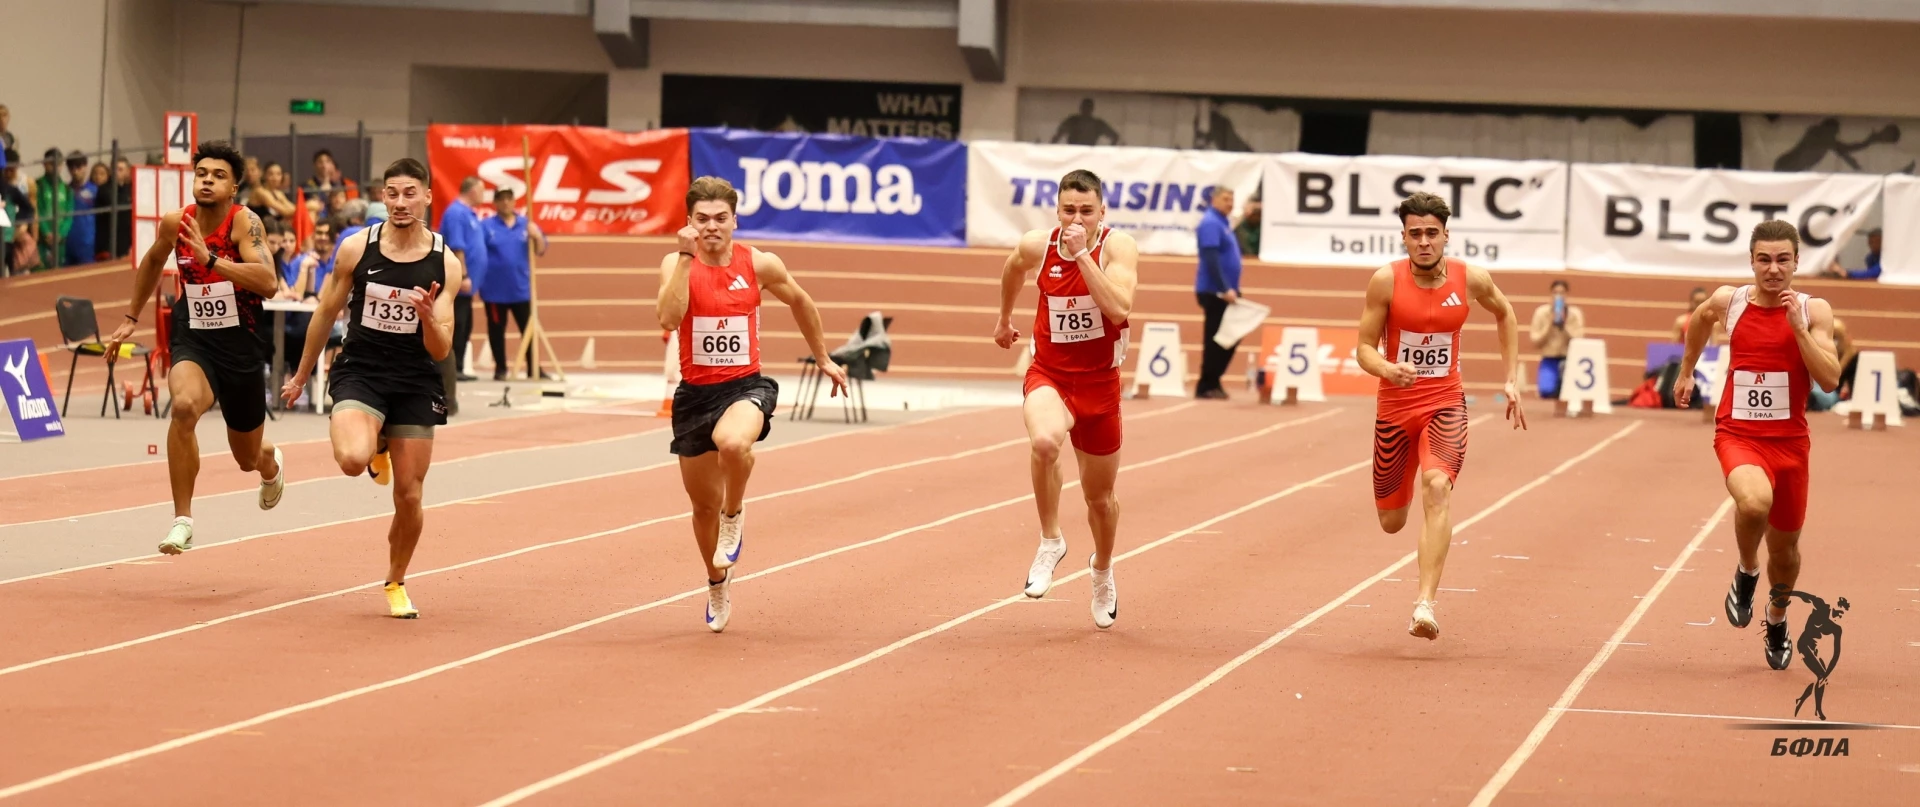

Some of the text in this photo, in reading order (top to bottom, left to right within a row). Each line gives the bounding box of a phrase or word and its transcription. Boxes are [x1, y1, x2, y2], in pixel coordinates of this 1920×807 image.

[877, 92, 953, 116] WHAT
[169, 116, 190, 153] 4
[826, 116, 953, 140] MATTERS
[477, 154, 662, 204] SLS
[1010, 177, 1218, 212] TRNSINS
[539, 203, 574, 221] life
[582, 206, 649, 224] style
[1604, 195, 1838, 248] BLSTC
[194, 300, 226, 317] 999
[369, 300, 416, 322] 1333
[1056, 312, 1093, 331] 785
[703, 335, 740, 353] 666
[1149, 346, 1171, 377] 6
[1287, 344, 1309, 375] 5
[1402, 348, 1448, 365] 1965
[1575, 357, 1595, 390] 3
[1748, 390, 1773, 407] 86
[1871, 371, 1882, 403] 1
